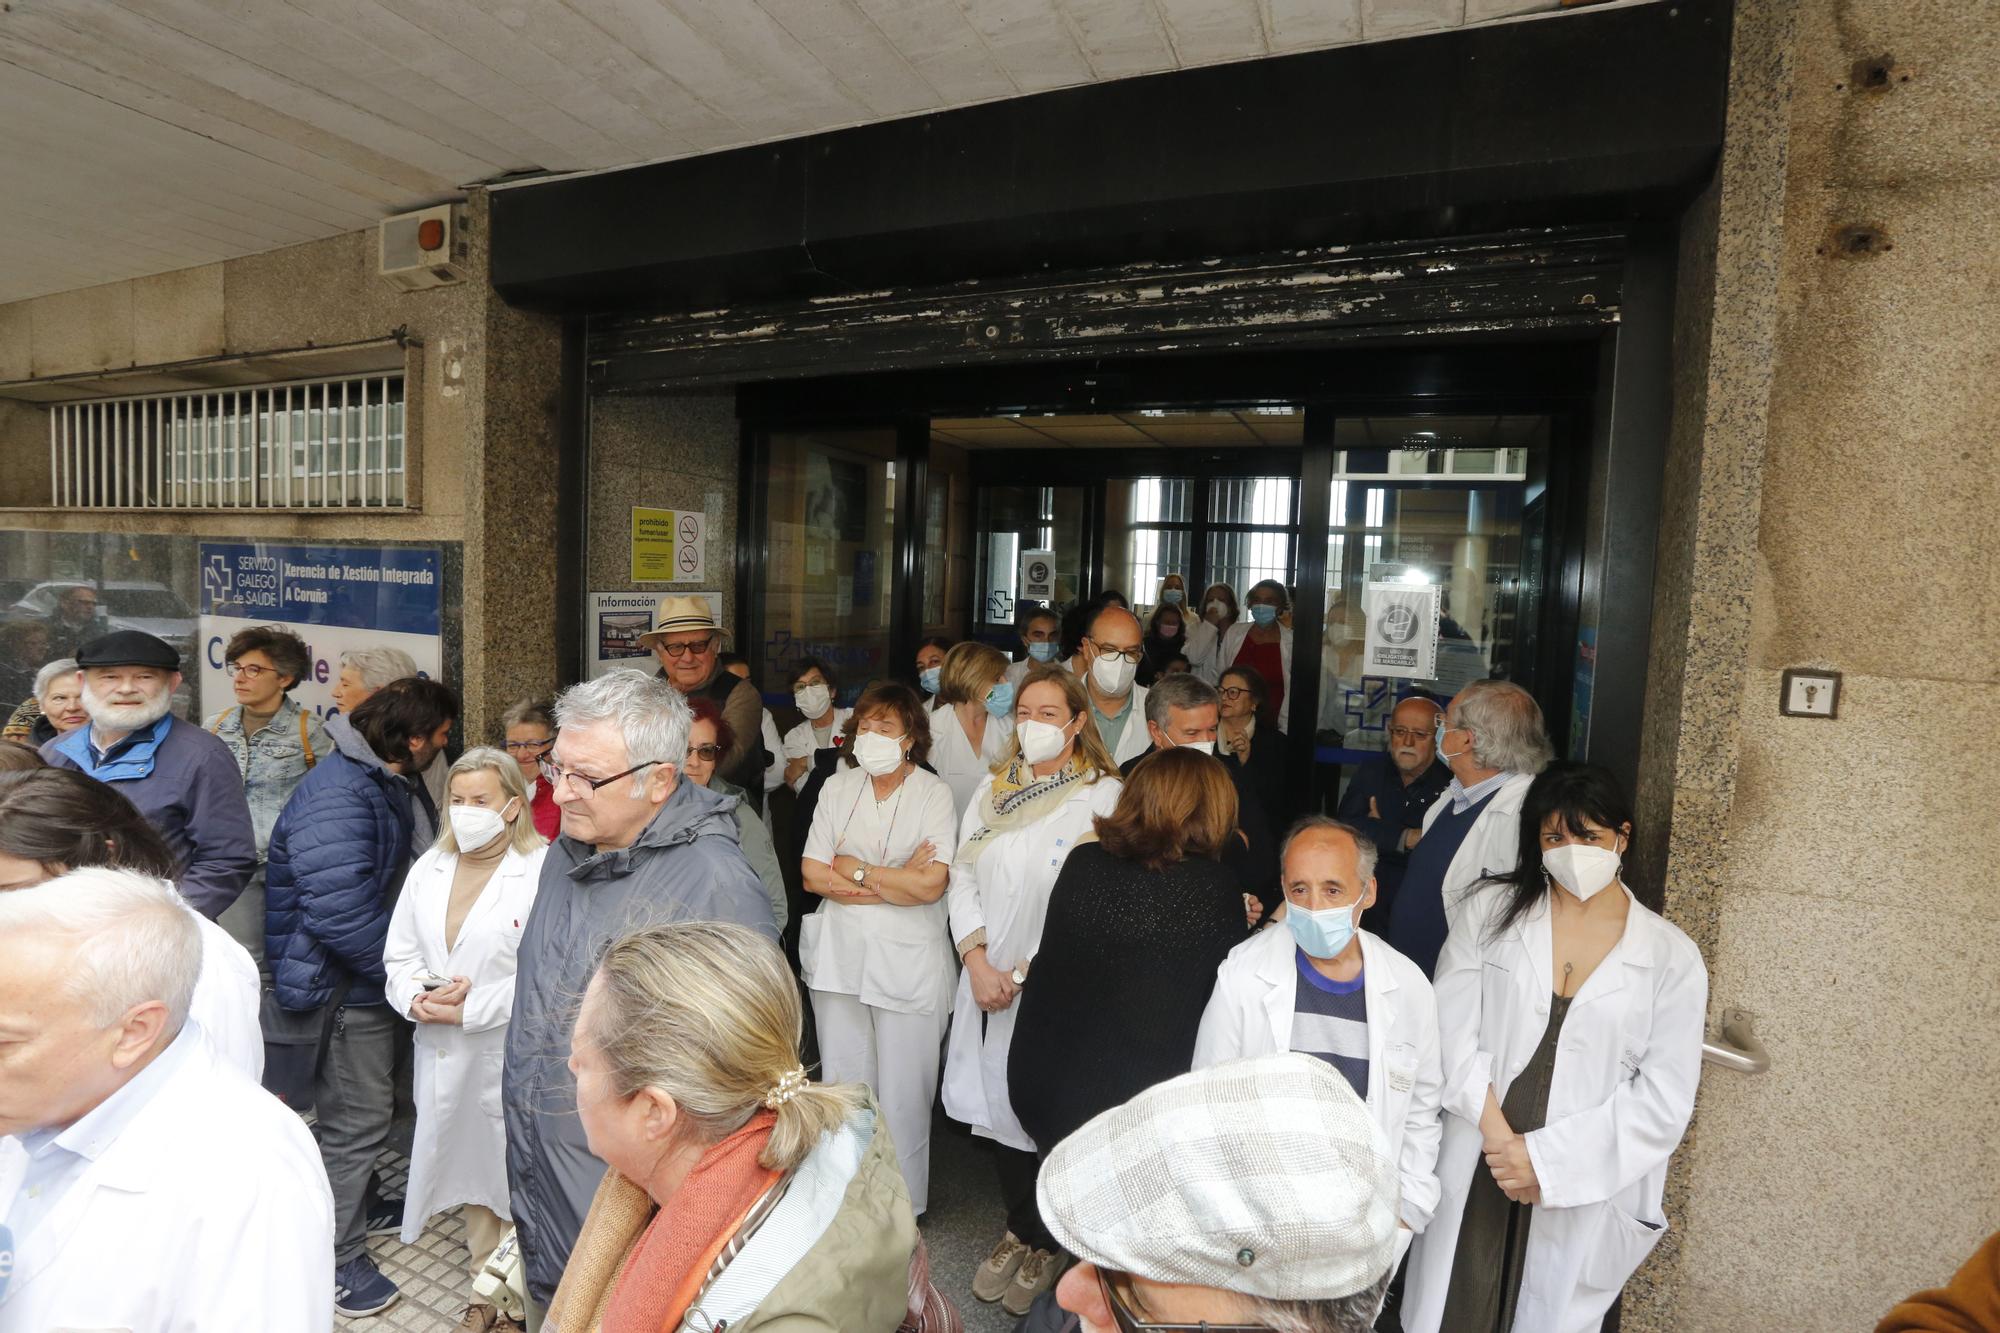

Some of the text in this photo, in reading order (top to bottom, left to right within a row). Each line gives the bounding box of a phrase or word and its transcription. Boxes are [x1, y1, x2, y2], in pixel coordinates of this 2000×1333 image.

[639, 519, 669, 527] prohibido
[238, 556, 277, 571] SERVIZO
[237, 573, 277, 589] GALEGO
[284, 563, 434, 585] Xerencia de Xestión Integrada
[233, 588, 276, 607] de SAÚDE
[285, 587, 328, 603] A Coruña
[598, 596, 656, 608] Información
